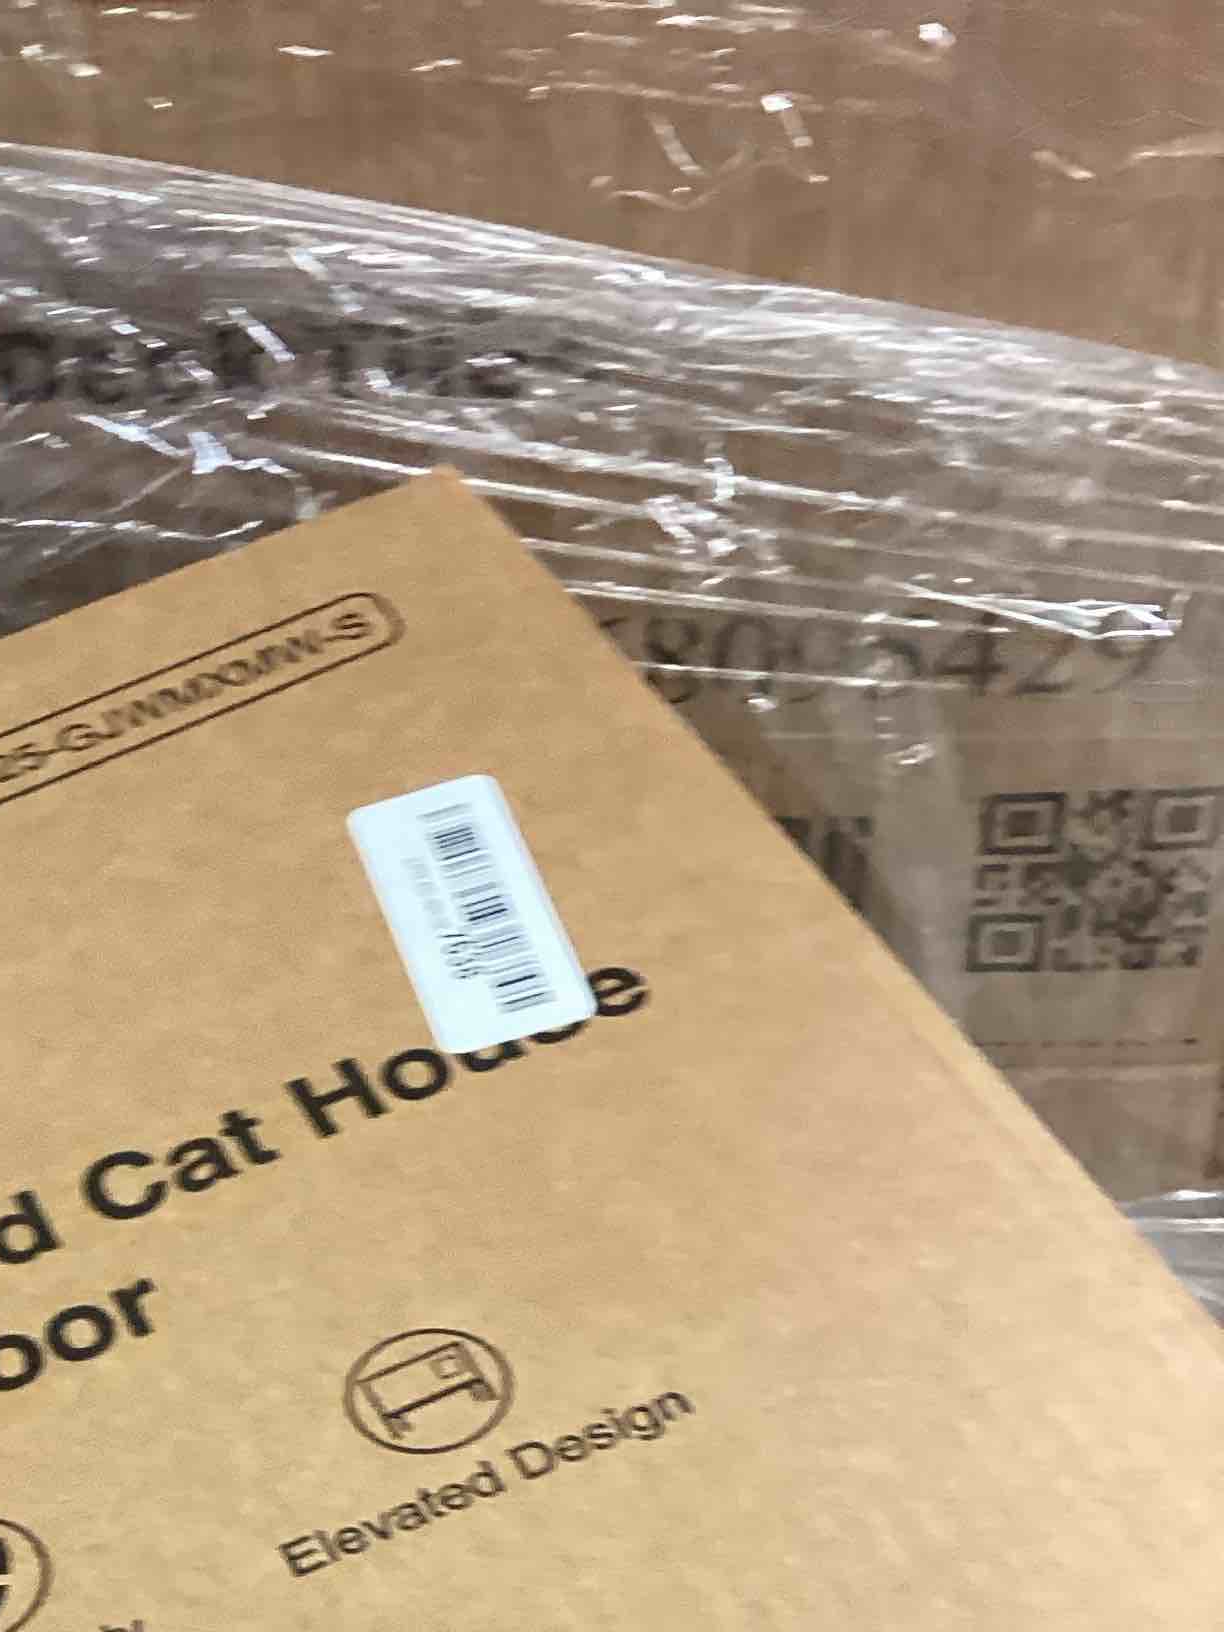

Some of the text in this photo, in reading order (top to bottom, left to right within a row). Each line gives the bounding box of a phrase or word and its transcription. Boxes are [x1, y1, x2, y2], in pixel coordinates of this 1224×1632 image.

[81, 1109, 284, 1220] Cat
[285, 966, 652, 1138] Hoe
[279, 1389, 696, 1577] Elevated Design
